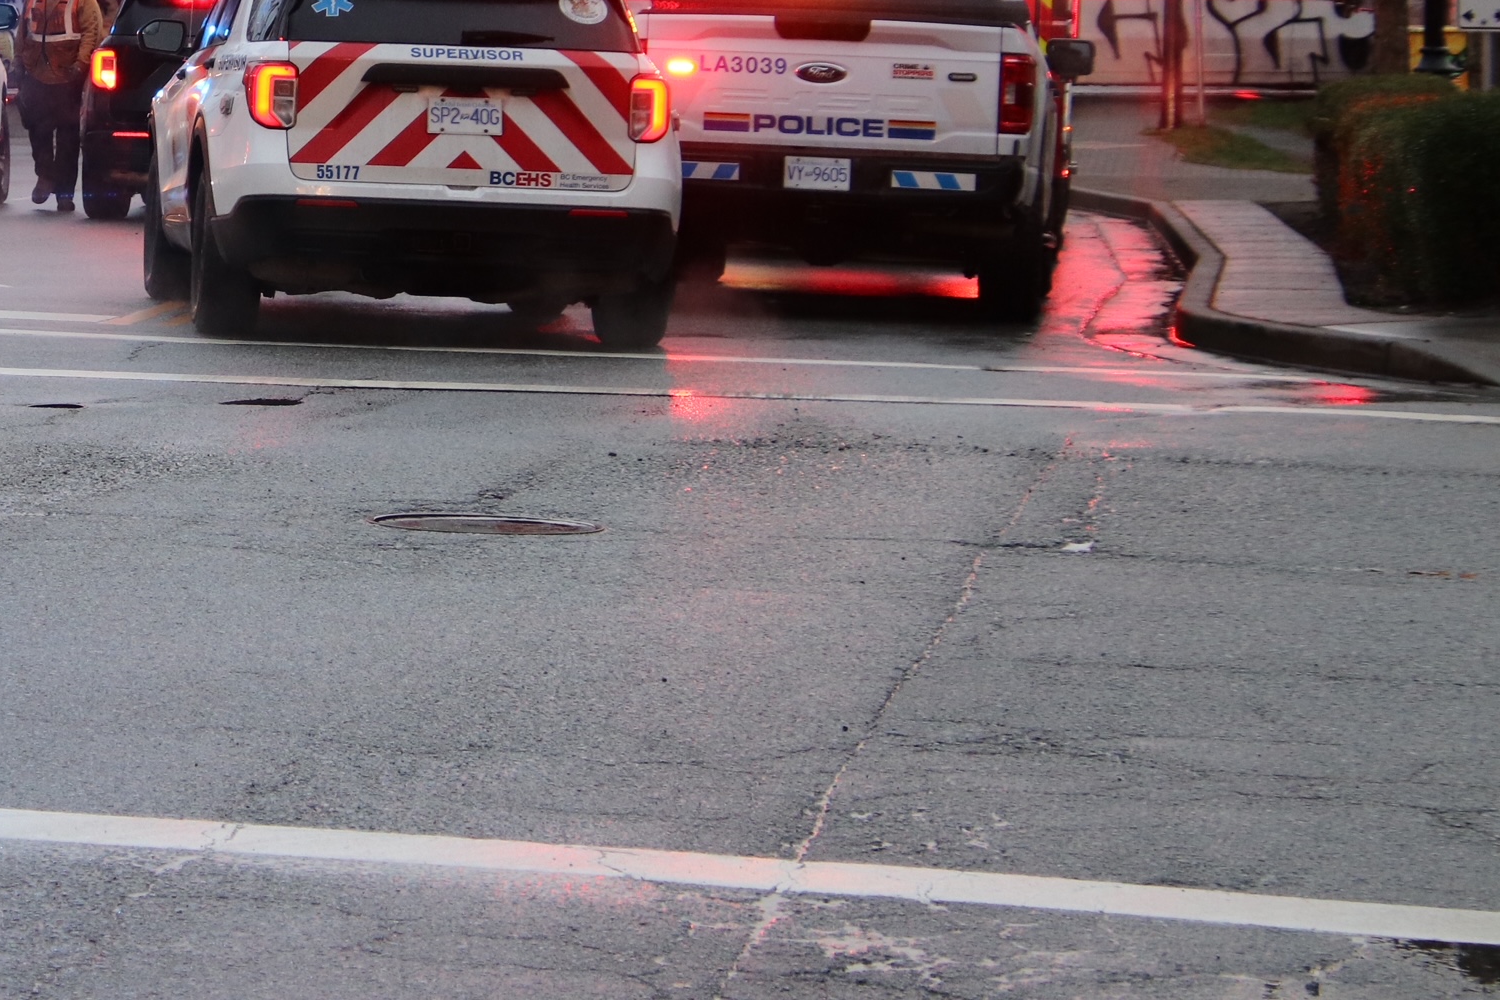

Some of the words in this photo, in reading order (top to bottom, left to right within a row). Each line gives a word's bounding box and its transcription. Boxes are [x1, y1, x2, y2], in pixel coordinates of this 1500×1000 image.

[410, 47, 524, 61] SUPERVISOR
[700, 54, 788, 75] LA3039
[808, 66, 836, 79] Ford
[753, 113, 885, 138] POLICE
[316, 164, 360, 180] 55177
[489, 171, 552, 188] BCEHS
[560, 173, 570, 181] BC
[572, 174, 608, 182] Emergency
[582, 182, 610, 190] Services
